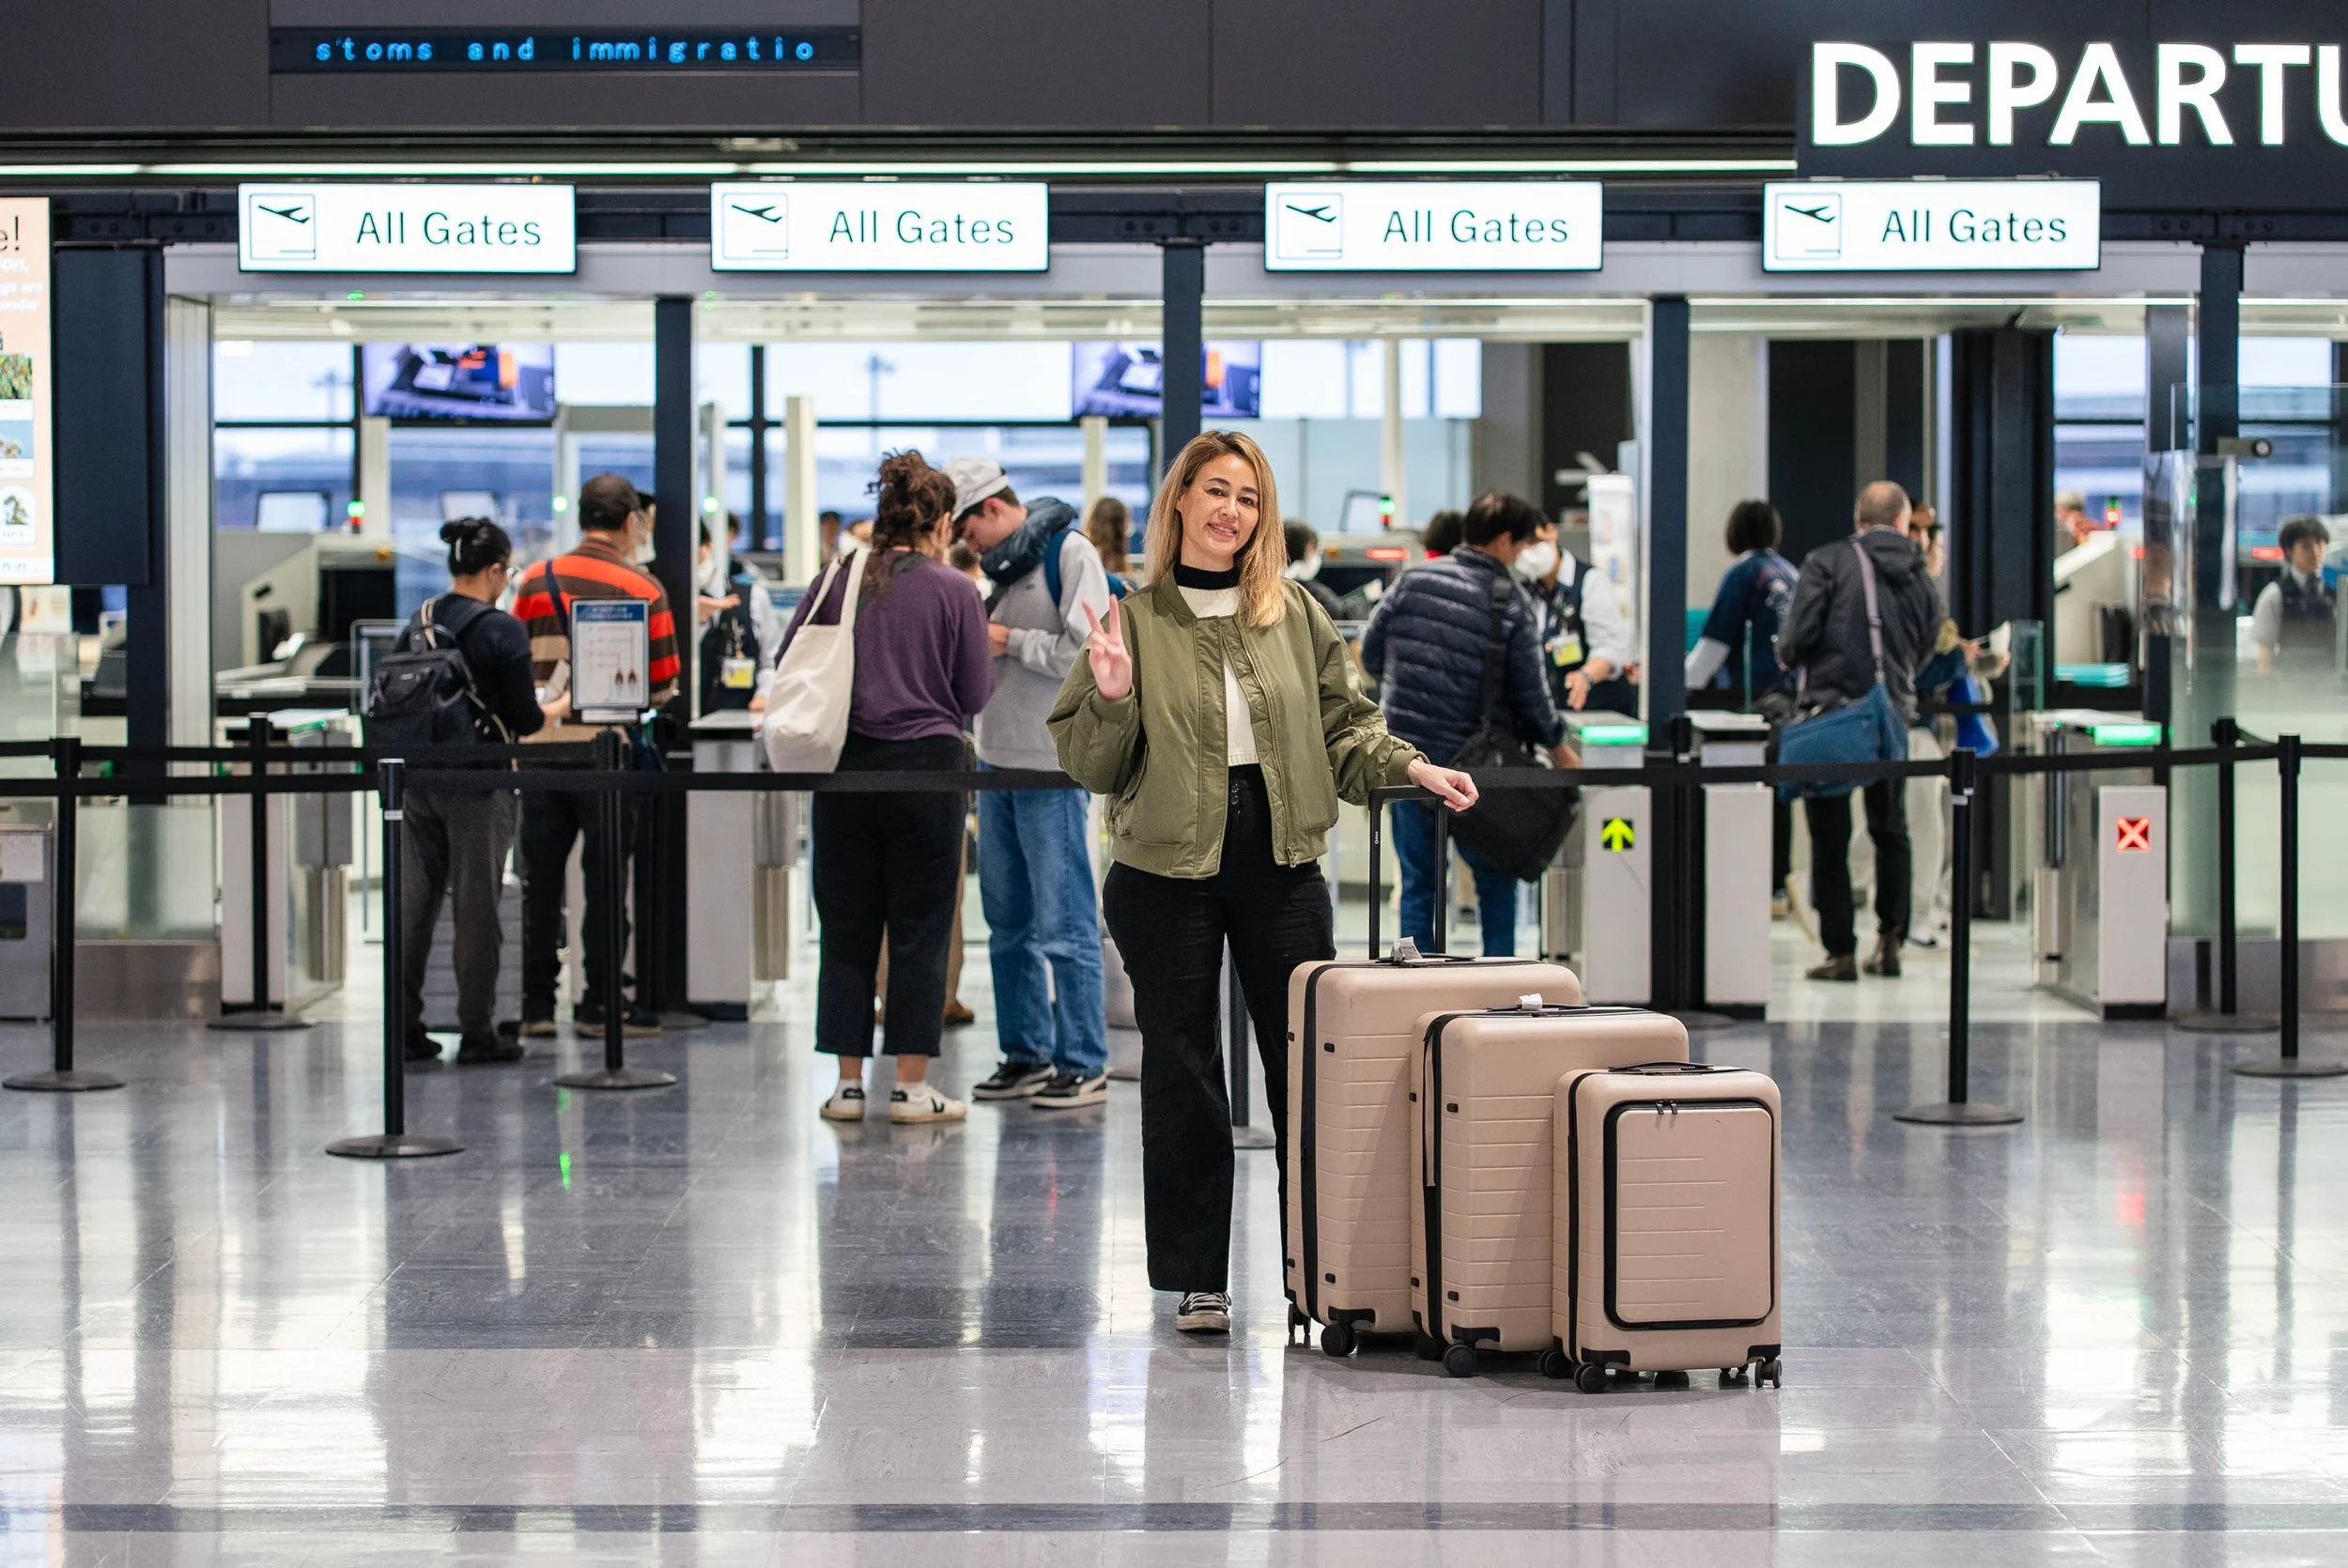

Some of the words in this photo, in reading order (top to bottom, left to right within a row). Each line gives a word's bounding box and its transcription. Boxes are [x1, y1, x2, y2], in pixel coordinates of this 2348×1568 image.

[316, 37, 433, 61] stoms
[467, 37, 534, 61] and
[572, 36, 814, 64] immigratio
[356, 210, 404, 244] All
[424, 210, 541, 245] Gates
[829, 209, 877, 243] All
[897, 209, 1013, 244] Gates
[1383, 208, 1431, 242] All
[1450, 208, 1568, 243] Gates
[1881, 208, 1930, 242] All
[1949, 208, 2066, 242] Gates
